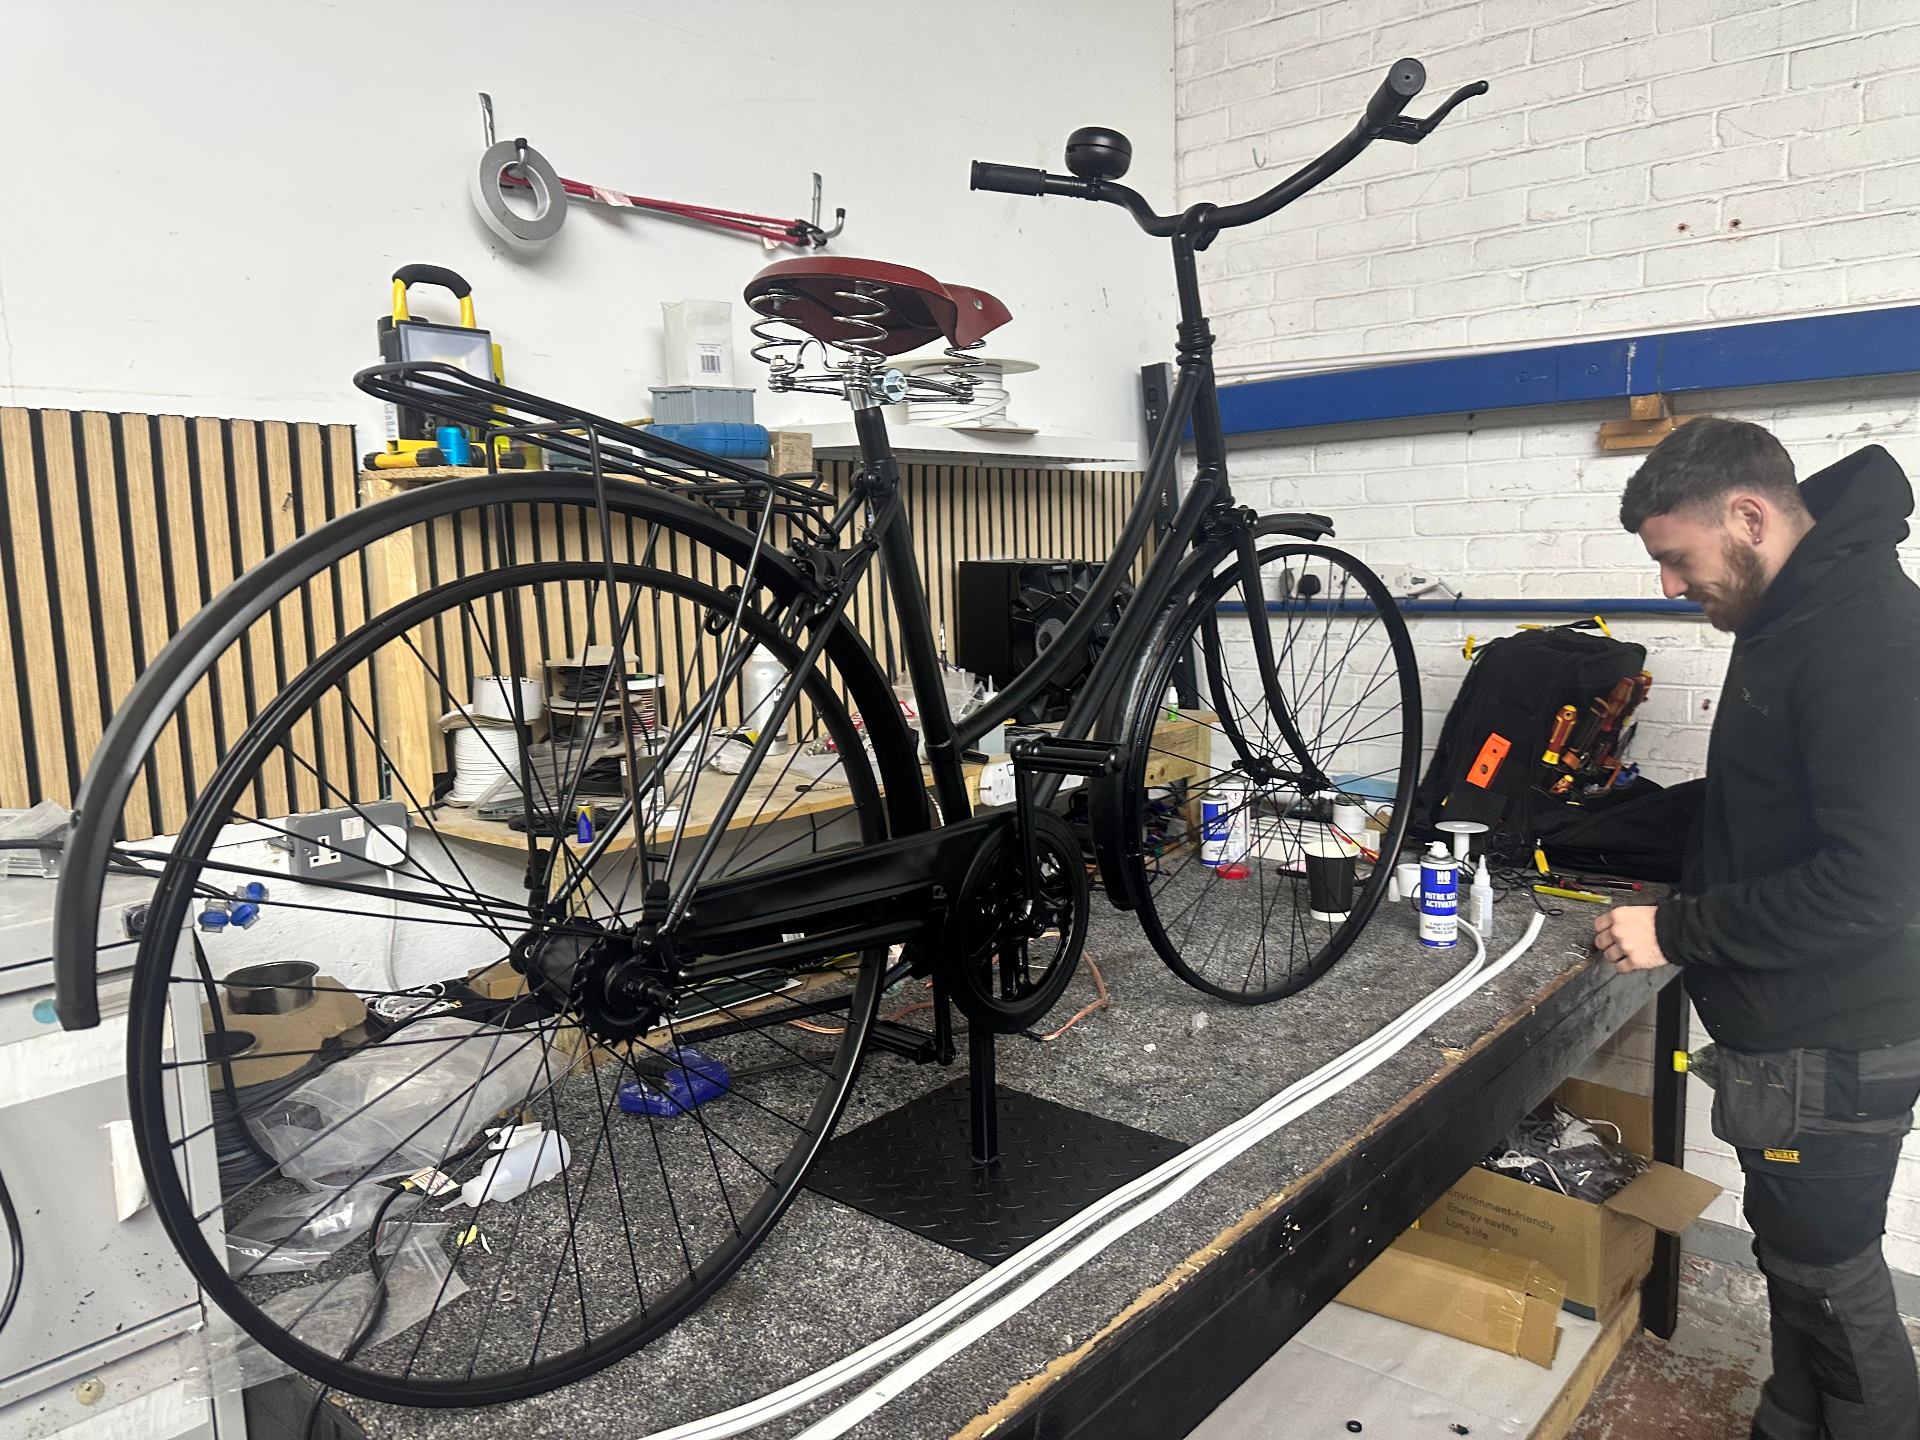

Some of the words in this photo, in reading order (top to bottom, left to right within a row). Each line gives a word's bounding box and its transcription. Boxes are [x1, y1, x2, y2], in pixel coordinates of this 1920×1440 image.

[1437, 871, 1451, 881] NO
[1425, 892, 1446, 901] MITRE
[1446, 1202, 1482, 1223] Energy
[1484, 1216, 1518, 1237] saving
[1447, 1188, 1555, 1233] Environment-friendly
[1446, 1217, 1471, 1235] Long
[1473, 1227, 1488, 1239] life
